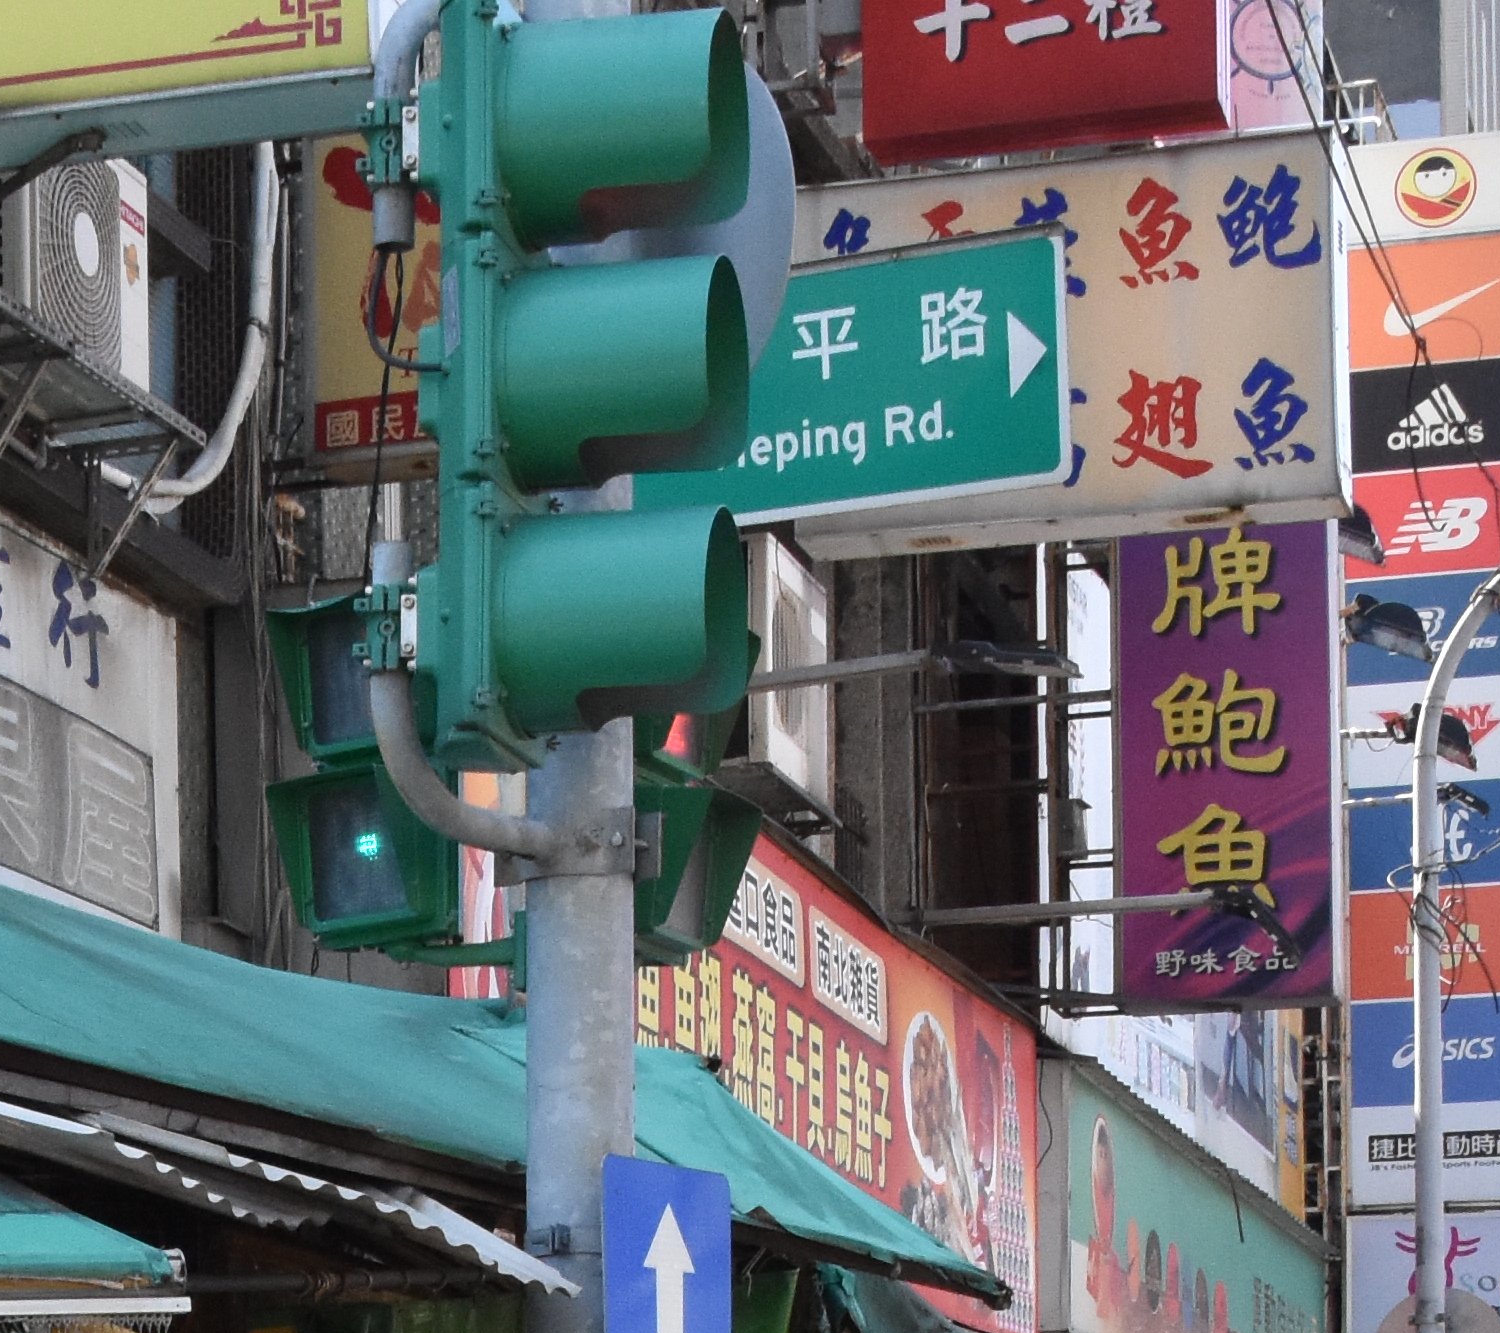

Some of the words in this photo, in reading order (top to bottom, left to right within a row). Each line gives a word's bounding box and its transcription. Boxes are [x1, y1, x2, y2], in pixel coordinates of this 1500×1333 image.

[1112, 177, 1213, 478] 魚翅
[1216, 164, 1322, 471] 鮑魚
[325, 402, 425, 447] 國民
[717, 419, 867, 472] eping
[885, 400, 954, 446] Rd.
[1387, 420, 1484, 450] adidas
[814, 920, 881, 1032] 南北雜貨
[1154, 941, 1296, 976] 野味食品
[1394, 942, 1486, 955] MRELL
